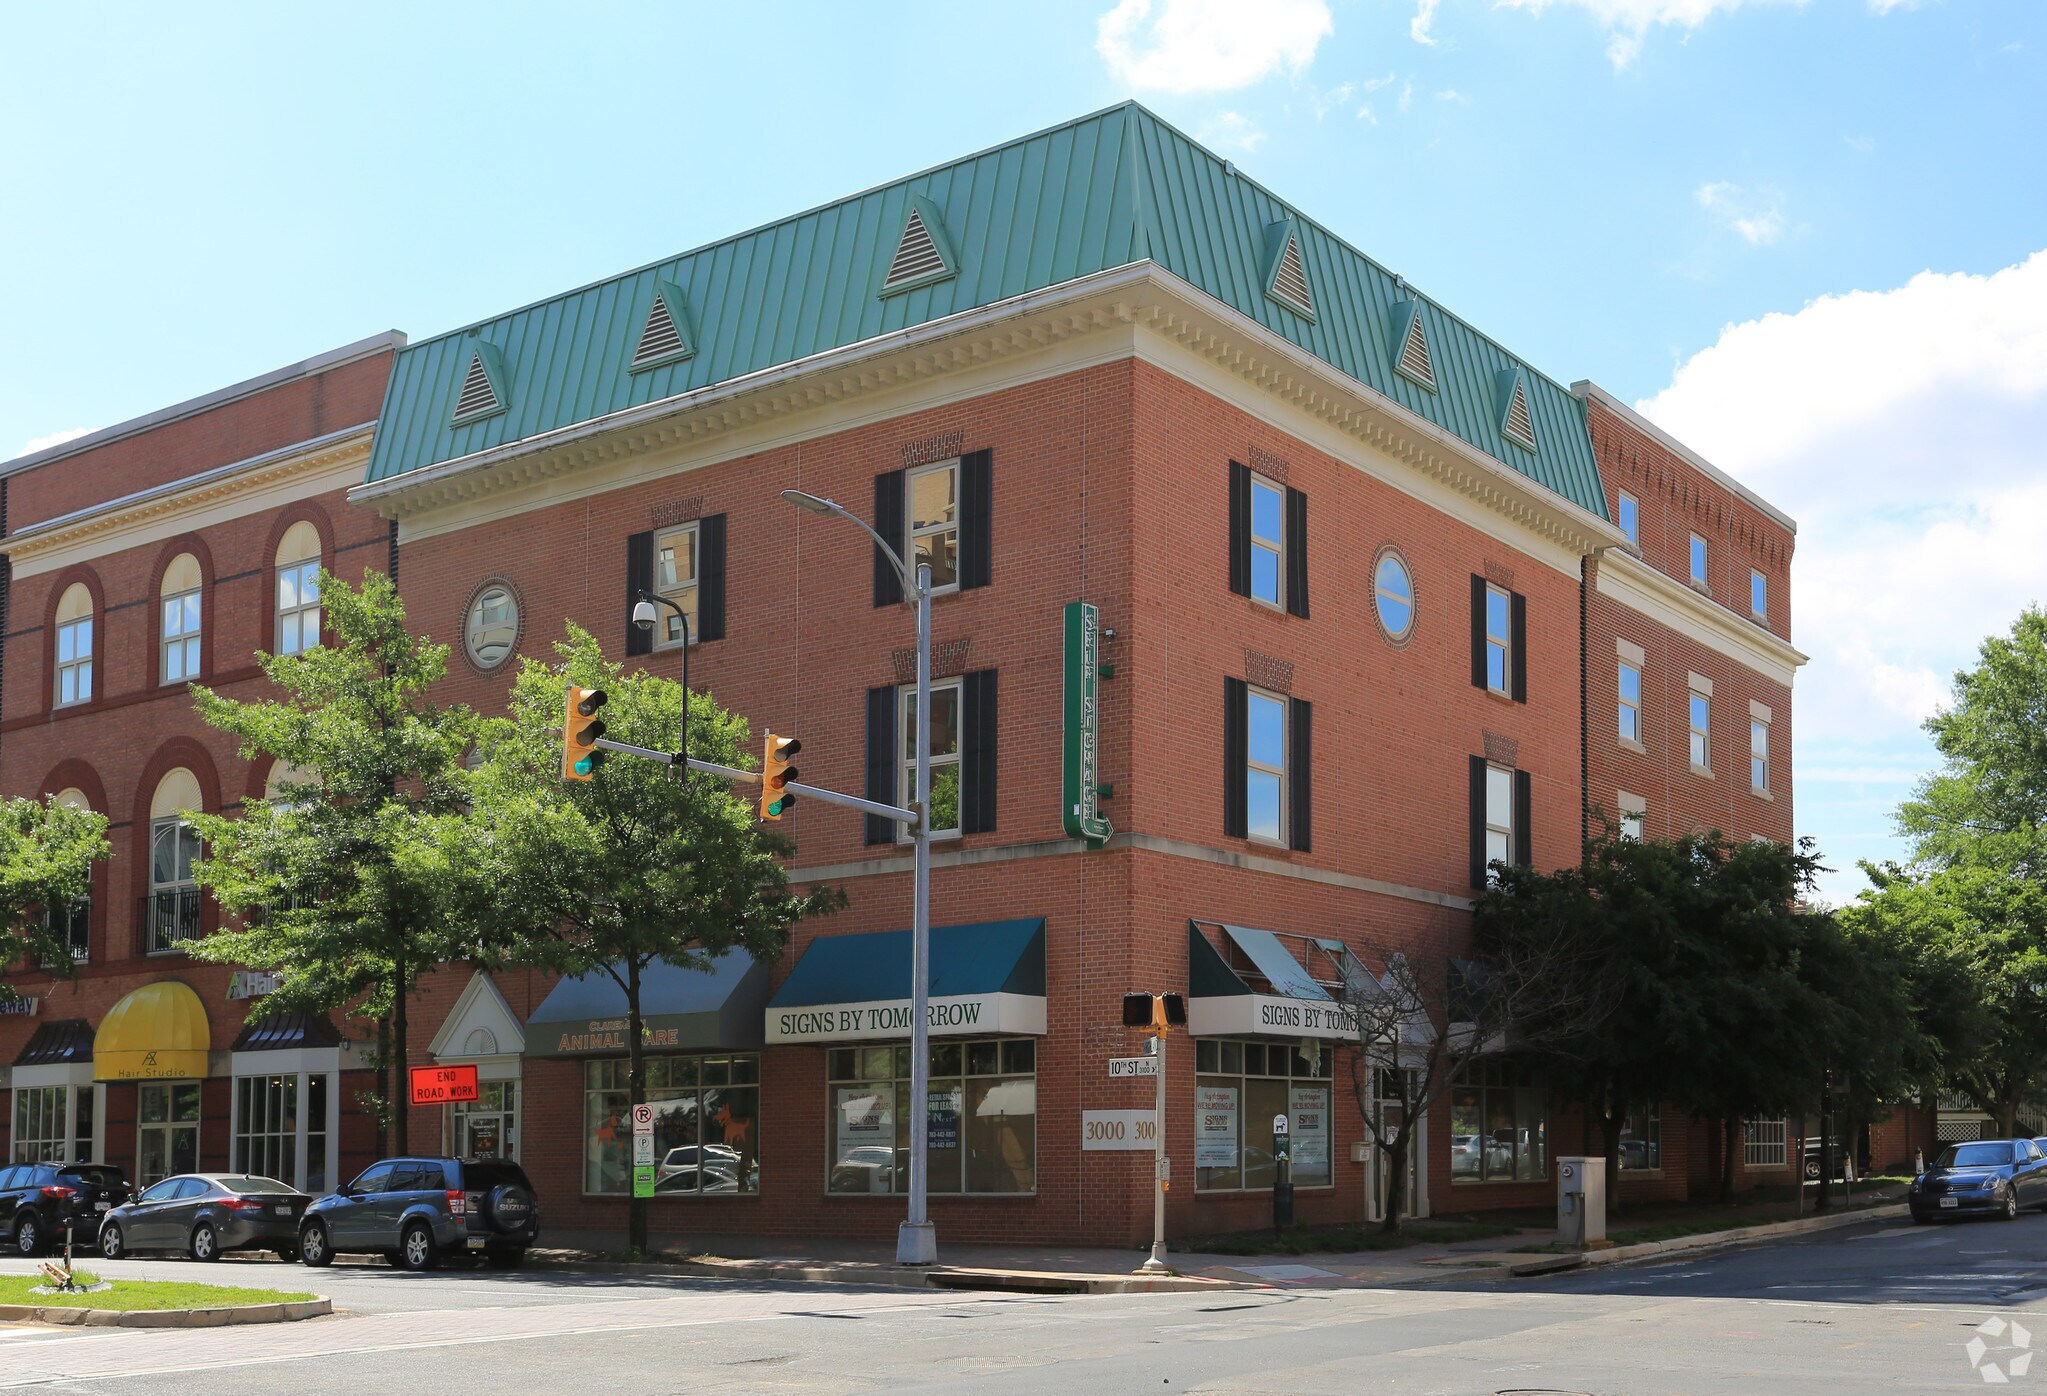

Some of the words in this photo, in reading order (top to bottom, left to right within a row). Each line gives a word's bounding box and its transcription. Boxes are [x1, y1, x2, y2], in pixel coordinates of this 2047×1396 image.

[780, 1011, 835, 1035] SIGNS
[839, 1009, 864, 1032] BY
[867, 1002, 982, 1031] TOMRROW
[1262, 1005, 1300, 1027] SIGNS
[1304, 1008, 1321, 1028] BY
[558, 1032, 625, 1051] ANIMAL
[641, 1028, 679, 1046] ARE
[118, 1069, 139, 1078] Hair
[145, 1067, 186, 1077] Studio
[1111, 1061, 1127, 1075] 10TH
[1128, 1061, 1139, 1074] ST
[437, 1071, 456, 1082] END
[416, 1087, 444, 1099] ROAD
[449, 1085, 473, 1097] WORK
[928, 1101, 939, 1111] FOR
[1086, 1120, 1125, 1141] 3000
[499, 1203, 529, 1211] SUZUKI
